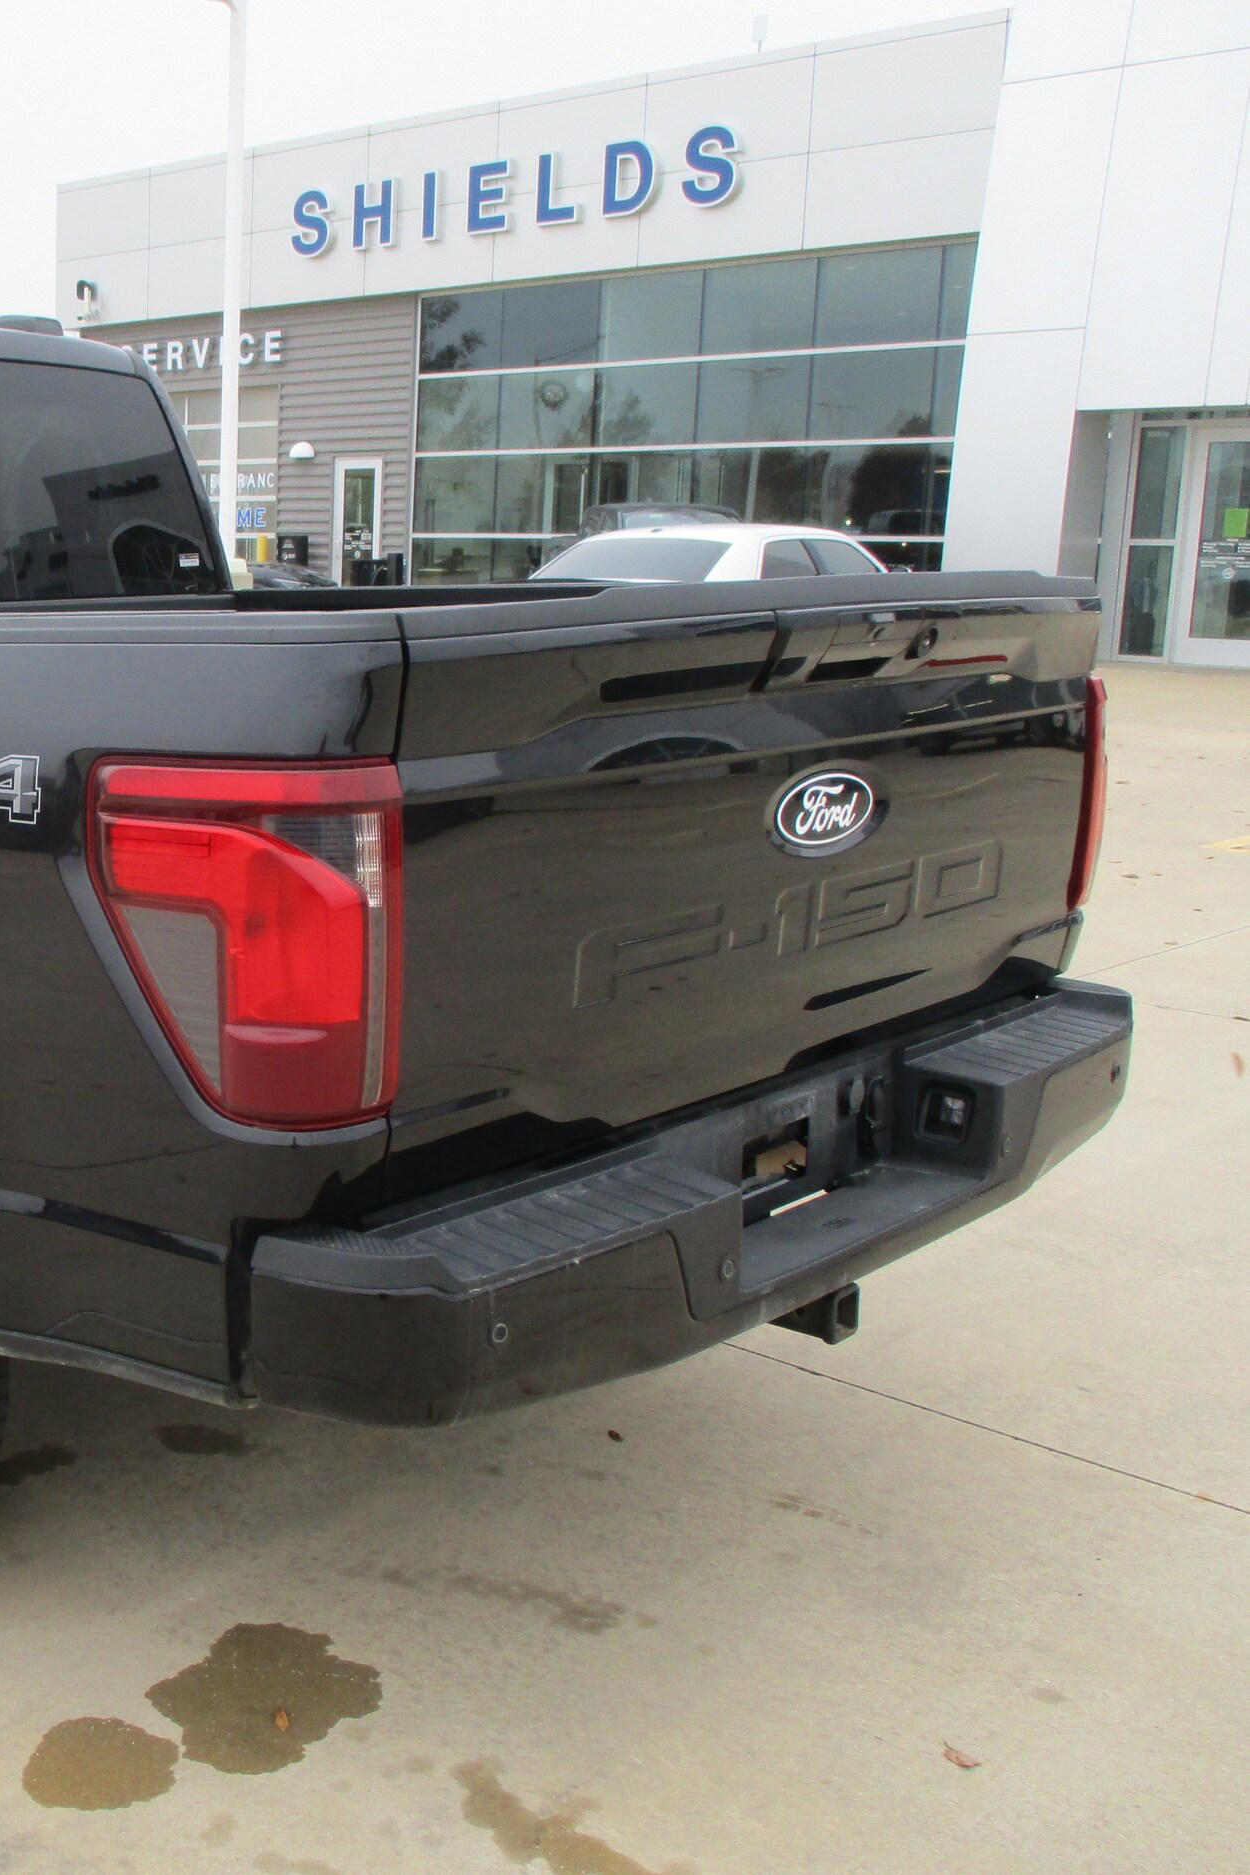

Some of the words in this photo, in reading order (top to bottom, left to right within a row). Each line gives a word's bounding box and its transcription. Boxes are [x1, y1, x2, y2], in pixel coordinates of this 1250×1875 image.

[289, 124, 743, 258] SHIELDS
[121, 330, 282, 372] ERVICE
[795, 783, 857, 836] Ford
[573, 840, 1004, 1009] F-150
